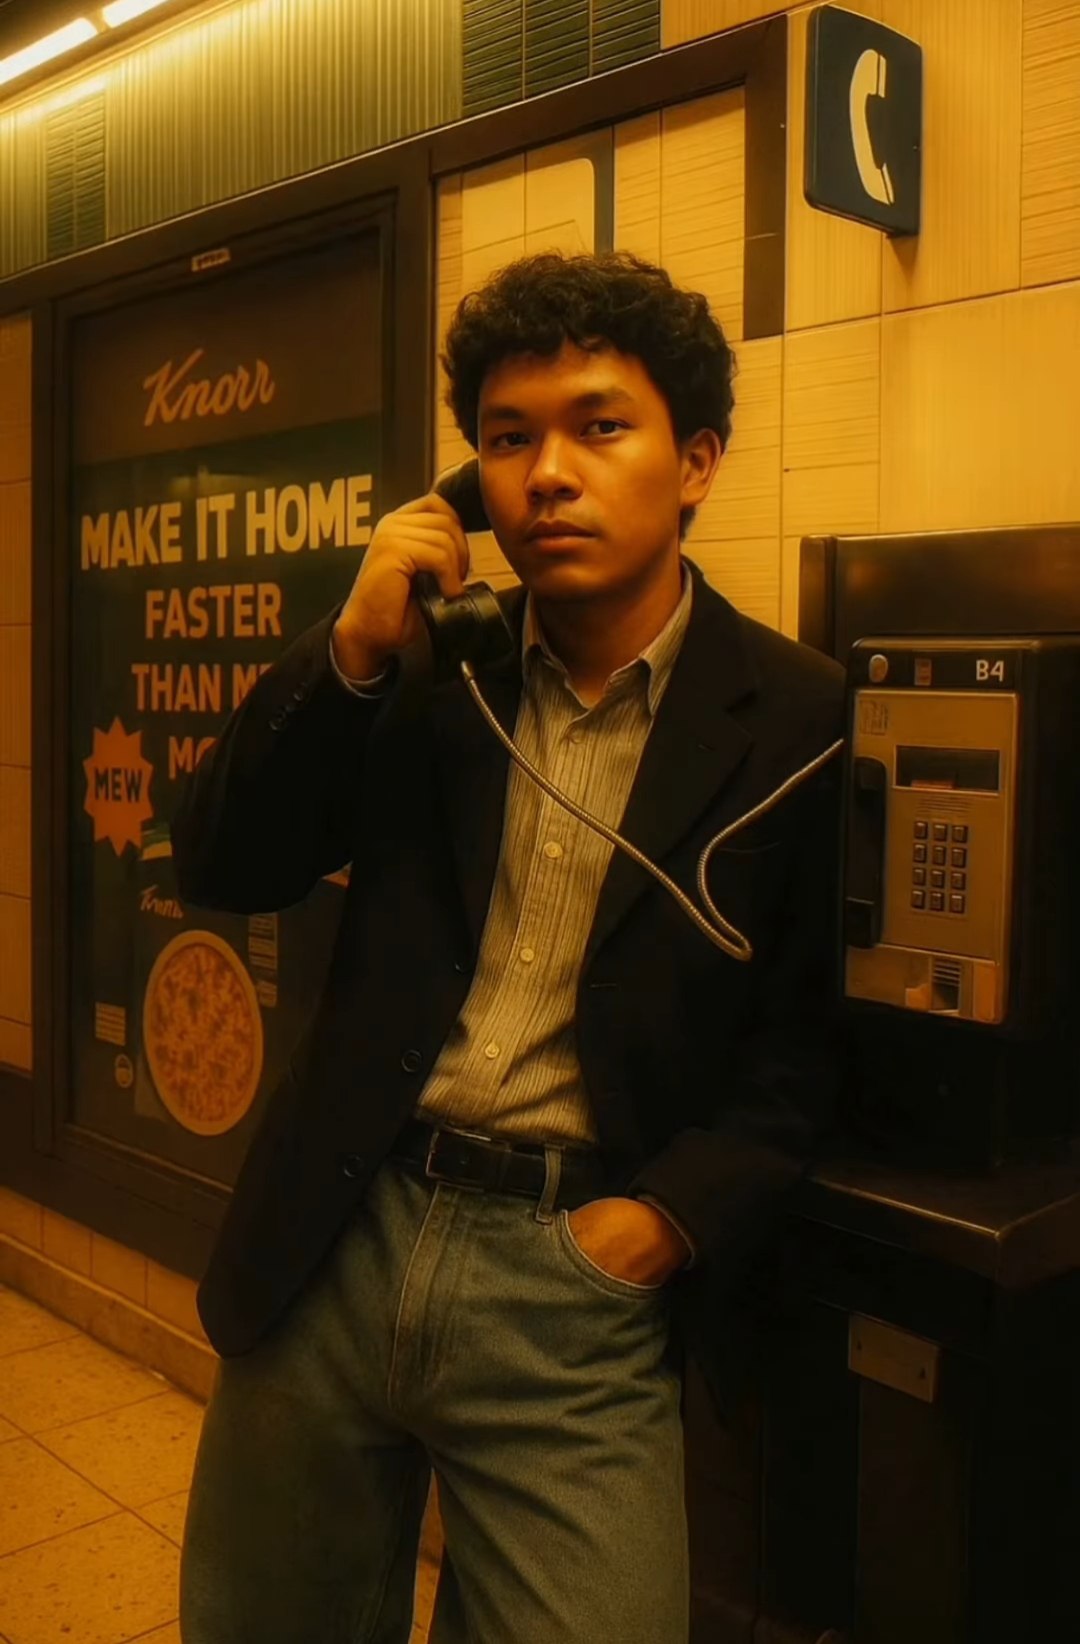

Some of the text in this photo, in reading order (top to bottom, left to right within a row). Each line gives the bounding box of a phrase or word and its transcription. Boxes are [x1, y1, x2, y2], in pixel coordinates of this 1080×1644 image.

[143, 348, 275, 426] Knorr
[81, 474, 372, 570] MAKE IT HOME
[146, 583, 282, 639] FASTER
[131, 664, 221, 712] THAN
[976, 660, 1004, 682] B4
[94, 767, 143, 802] MEW
